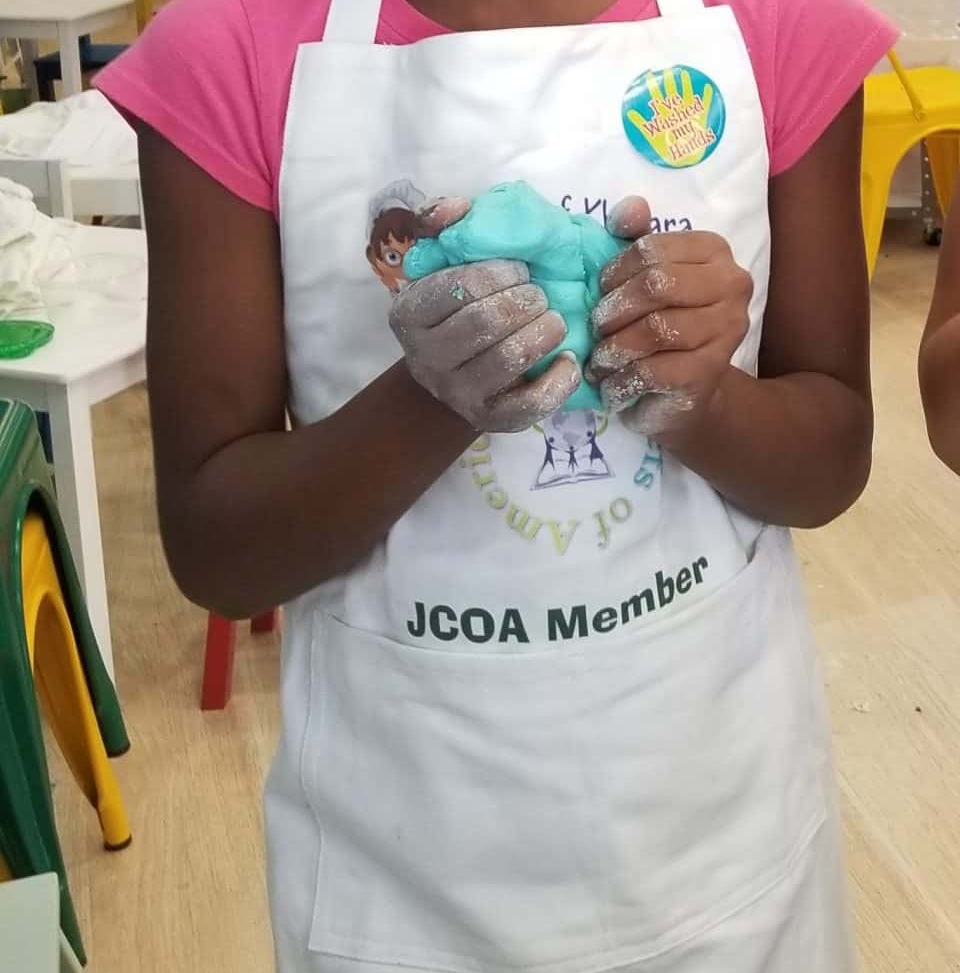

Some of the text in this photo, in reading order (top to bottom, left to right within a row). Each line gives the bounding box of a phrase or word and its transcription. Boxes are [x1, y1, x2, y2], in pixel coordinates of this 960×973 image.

[642, 96, 705, 135] Washed
[671, 122, 696, 140] my
[670, 129, 715, 160] Hands
[468, 433, 581, 557] Americ
[406, 556, 708, 644] JCOA Member
